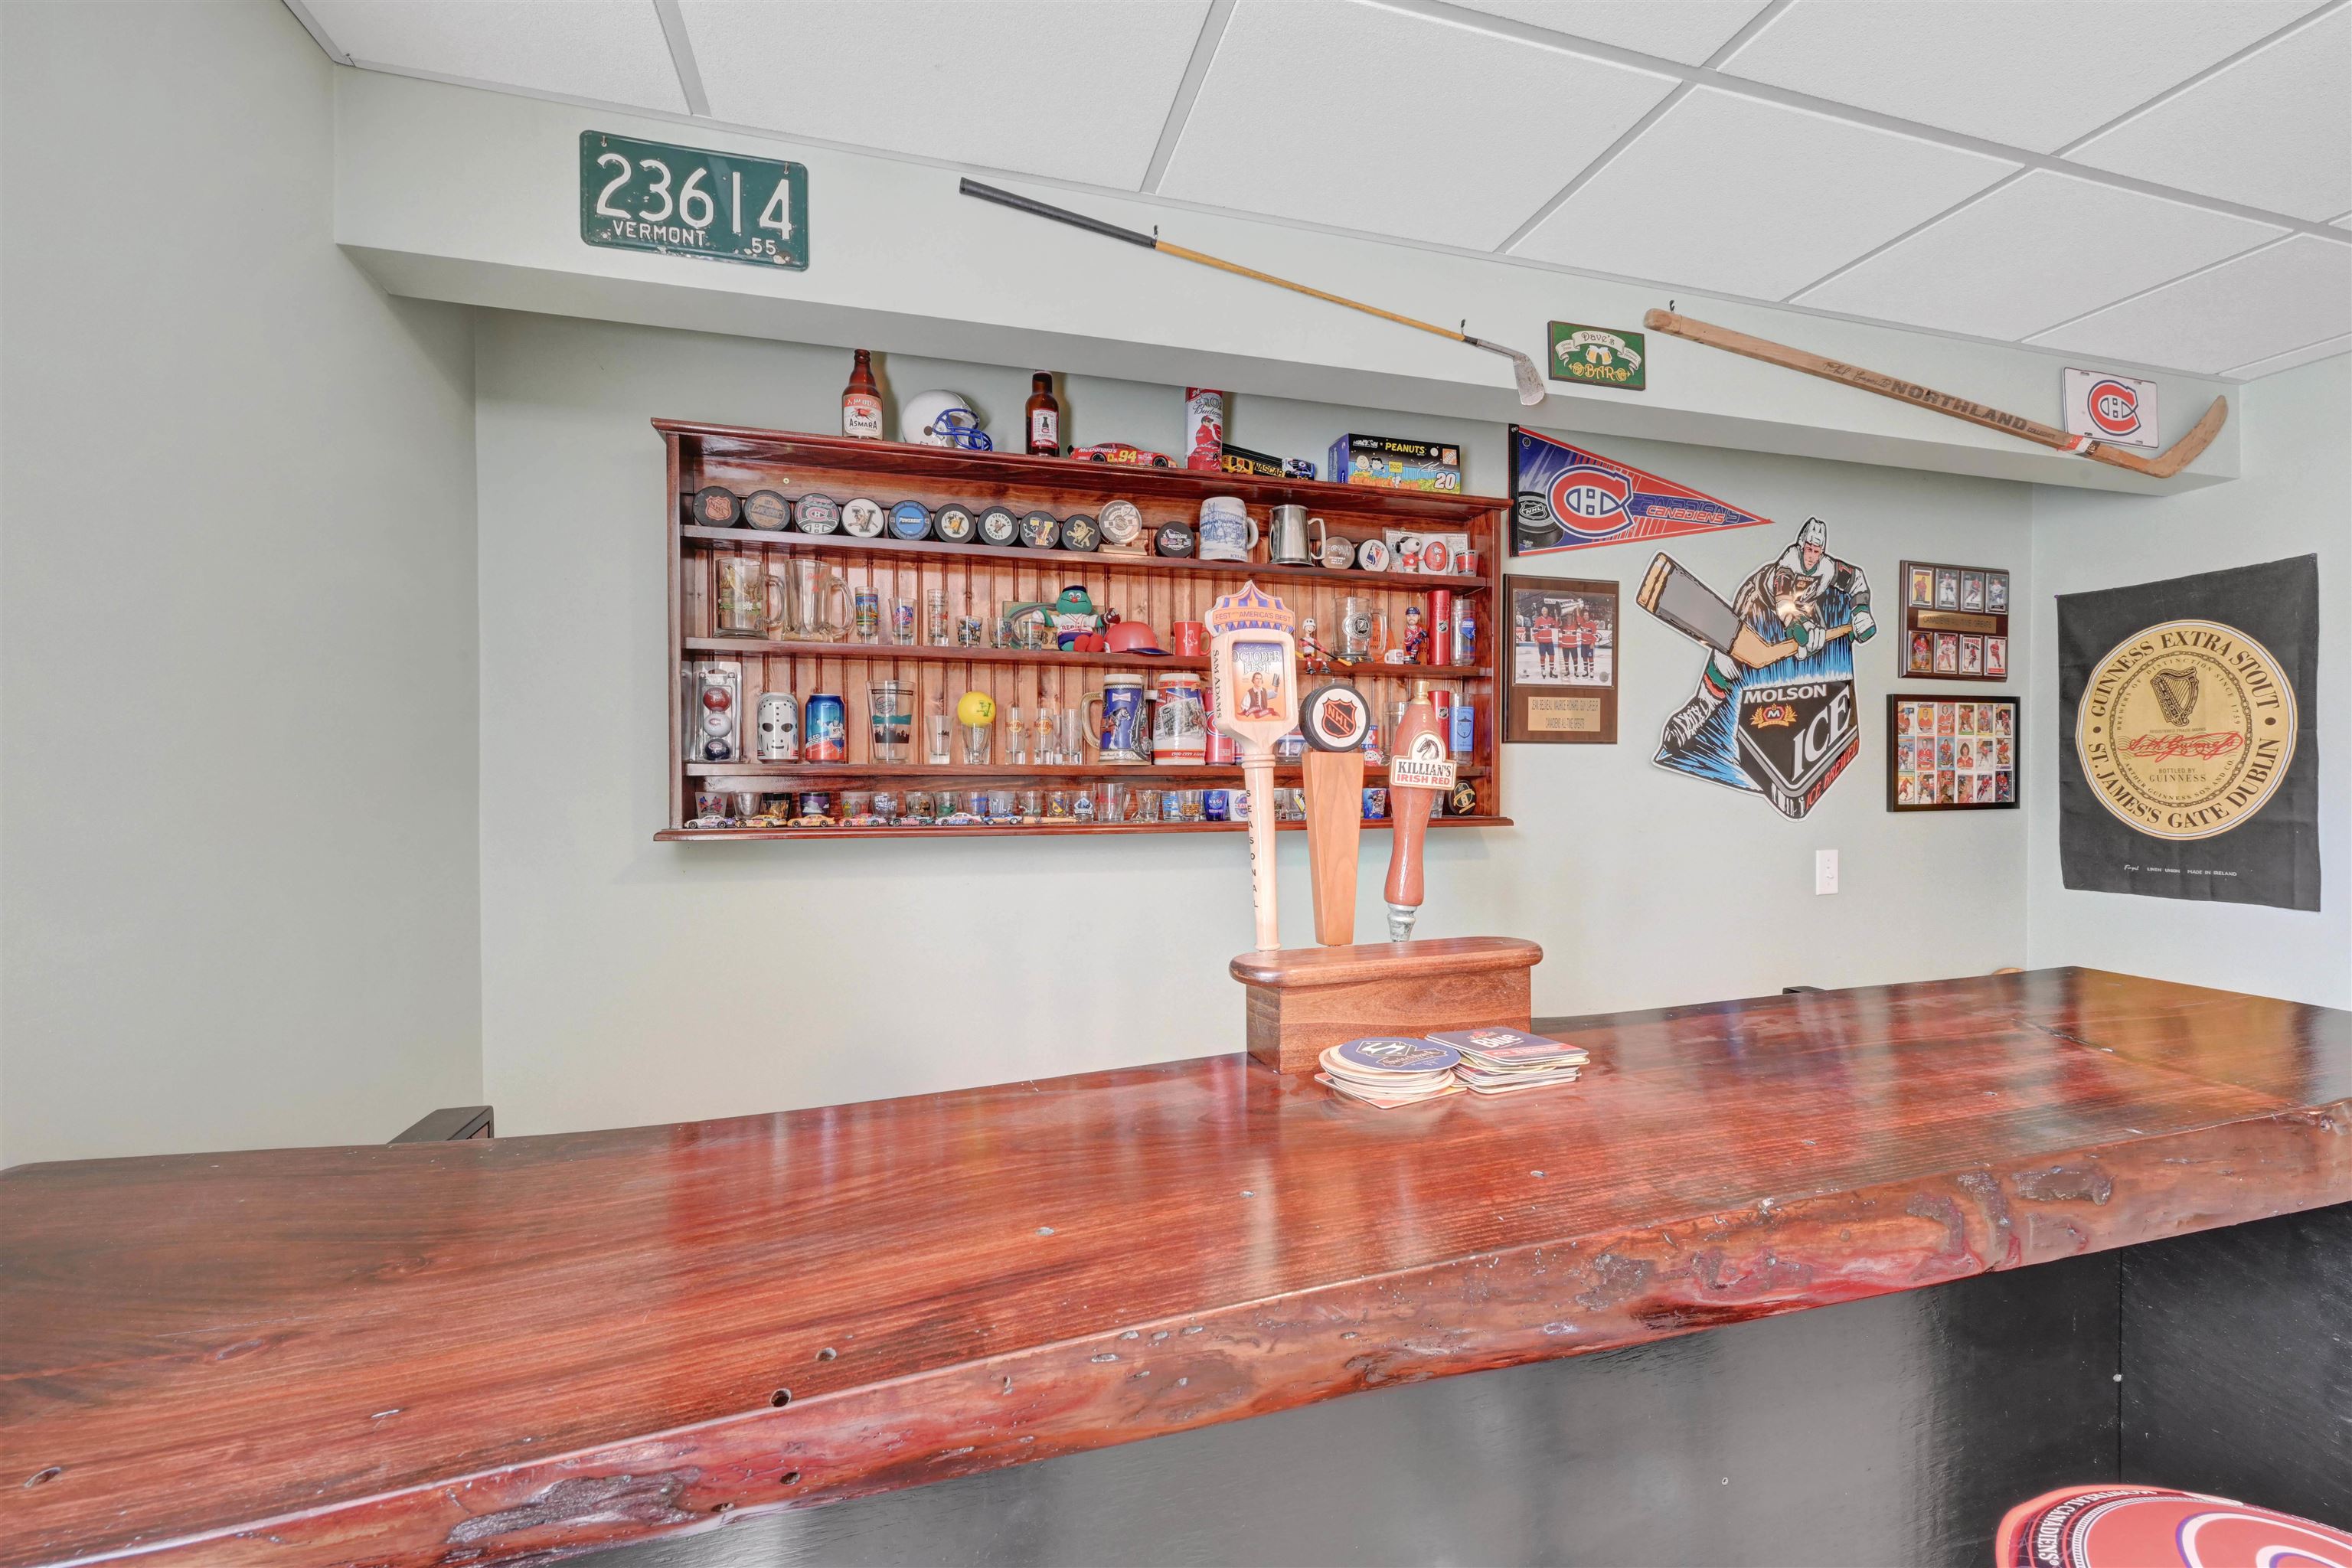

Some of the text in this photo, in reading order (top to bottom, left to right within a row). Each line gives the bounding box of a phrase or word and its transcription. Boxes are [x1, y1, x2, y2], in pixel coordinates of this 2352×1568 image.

[594, 152, 793, 240] 23614
[612, 219, 706, 247] VERMONT
[751, 238, 776, 256] 55
[1581, 332, 1615, 345] Dave's
[1585, 363, 1615, 381] BAR
[1891, 380, 2027, 431] NORTHLAND
[849, 418, 877, 430] ASMARA
[1118, 449, 1137, 462] 94
[1385, 442, 1426, 455] PEANUTS
[1253, 462, 1284, 478] NASCAR
[1434, 472, 1456, 490] 20
[1525, 506, 1544, 515] NHL
[1239, 611, 1274, 619] AMERICA'S
[1276, 613, 1291, 622] BEST
[1232, 649, 1282, 662] OCTOBER
[1243, 662, 1272, 675] FEST
[2091, 630, 2280, 717] GUINNESS EXTRA STOUT
[1743, 684, 1827, 704] MOLSON
[2117, 658, 2241, 730] BREWERS OF DISTINCTION SINCE 1759
[1326, 707, 1351, 732] NHL
[1792, 686, 1852, 782] ICE
[1397, 761, 1452, 777] KILLIAN'S
[1806, 739, 1859, 809] ICE BREWED
[2149, 774, 2207, 782] GUINNESS
[1396, 773, 1450, 786] IRISH RED
[2088, 737, 2281, 828] ST. JAMES'S GATE DUBLIN
[2125, 760, 2235, 801] ARTHUR GUINNESS SON AND CO.
[1246, 789, 1259, 908] SEASONAL
[1470, 1034, 1522, 1049] Blue
